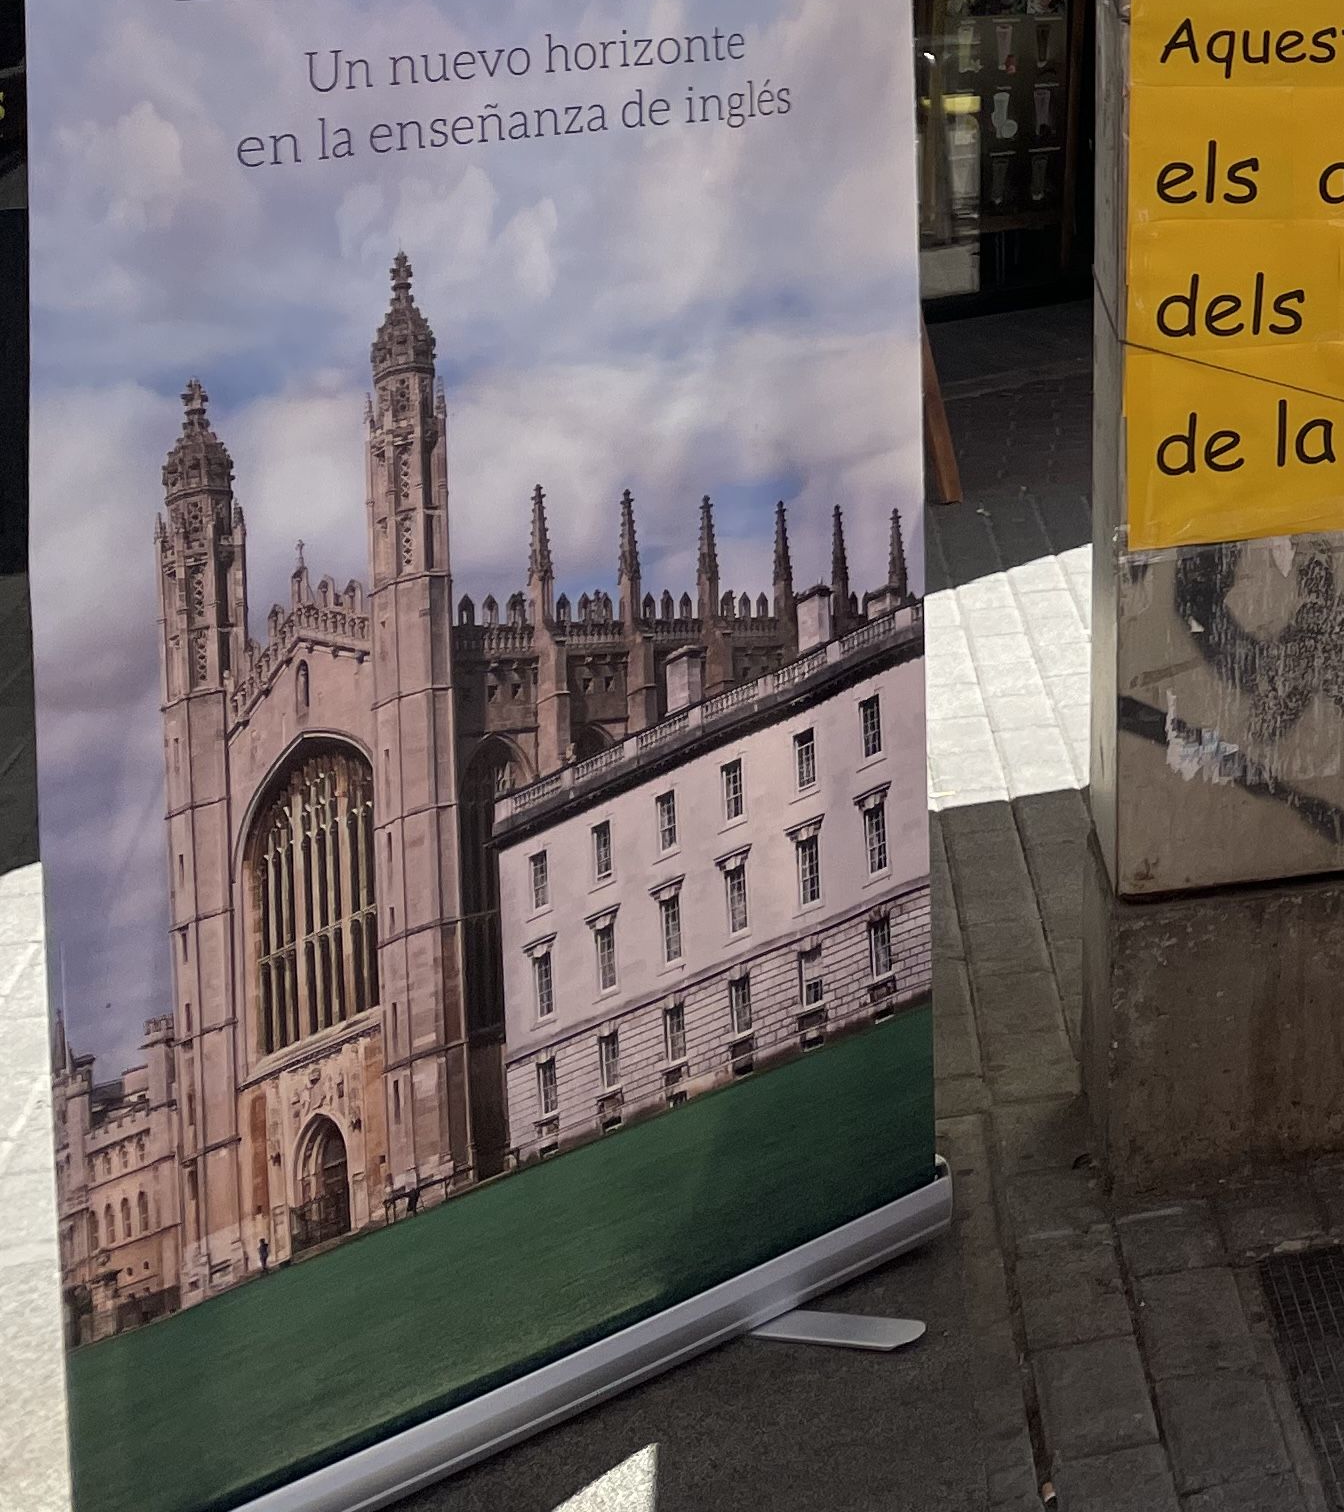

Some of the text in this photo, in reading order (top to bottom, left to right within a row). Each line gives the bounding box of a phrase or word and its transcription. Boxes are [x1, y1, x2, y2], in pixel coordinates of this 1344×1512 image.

[307, 27, 745, 94] Un nuevo horizonte
[238, 81, 791, 169] en la enseñanza de inglés
[1157, 141, 1259, 204] els
[1157, 273, 1305, 337] dels
[1157, 412, 1243, 475] de
[1277, 399, 1336, 467] la
